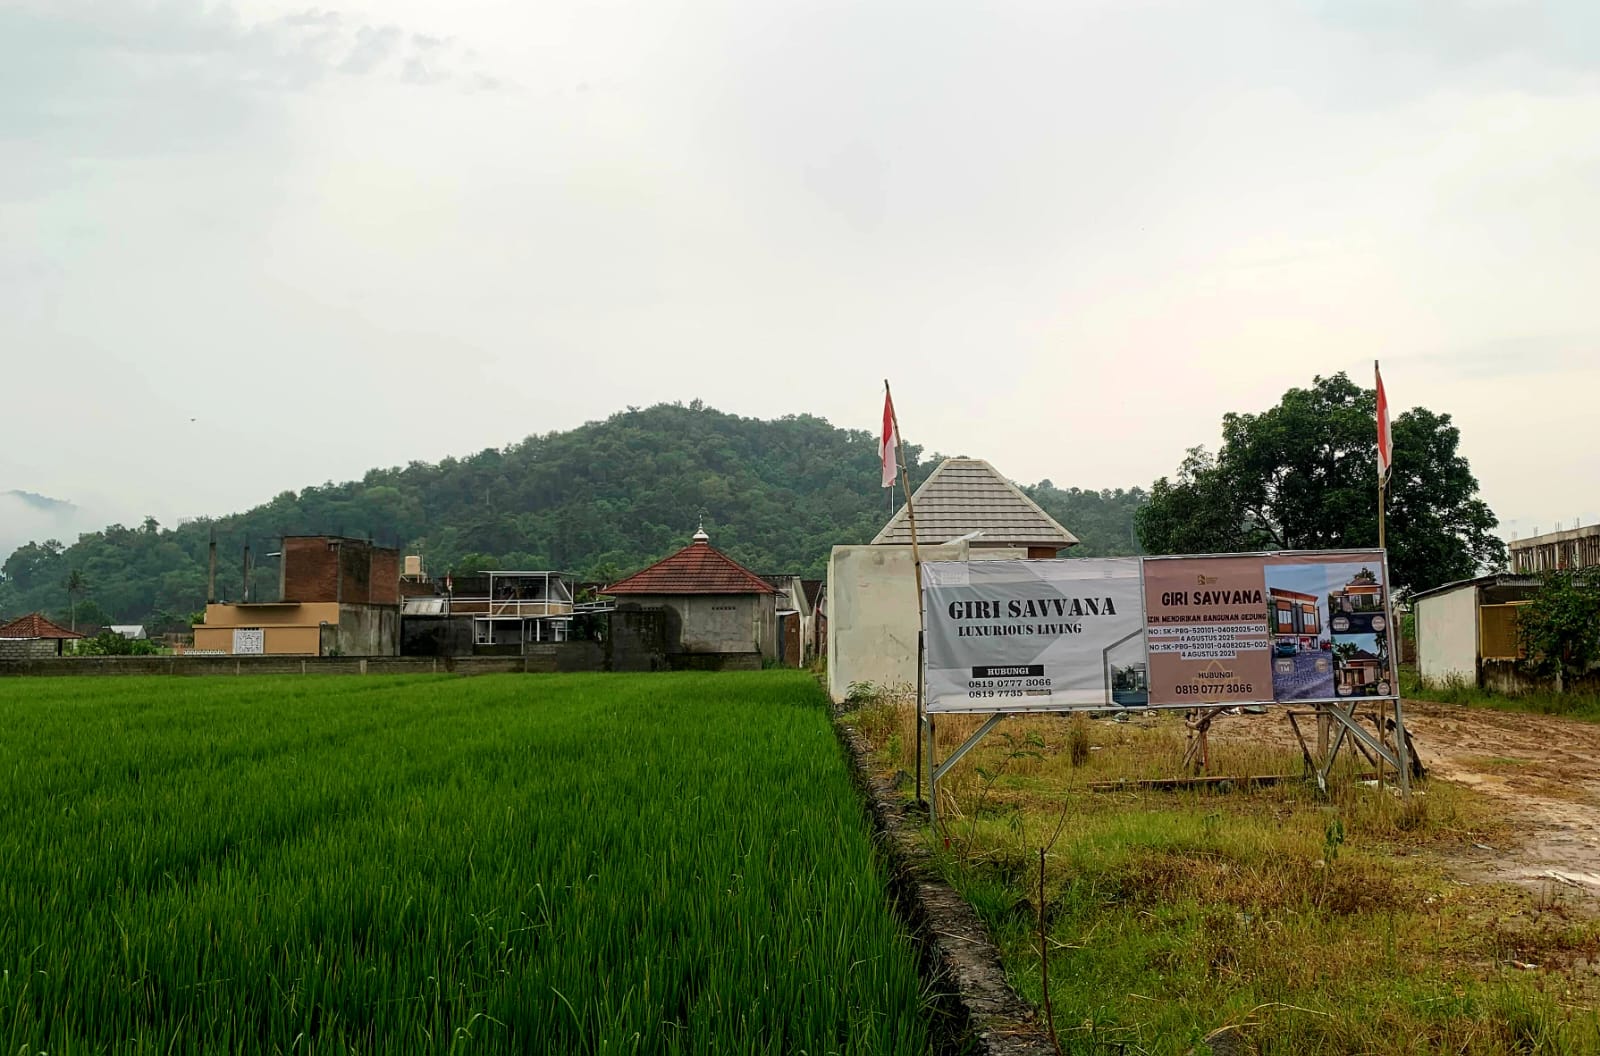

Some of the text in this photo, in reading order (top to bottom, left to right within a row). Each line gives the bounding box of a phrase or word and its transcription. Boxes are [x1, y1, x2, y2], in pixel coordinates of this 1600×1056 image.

[1162, 590, 1262, 606] GIRI SAVVANA
[949, 597, 1116, 619] GIRI SAVVANA
[1147, 613, 1267, 623] IZIN MENDIRIKAN BANGUNAN GEDUNG
[958, 624, 1082, 637] LUXURIOUS LIVING
[987, 667, 1029, 676] HUBUNGI
[1198, 671, 1233, 679] HUBUNGI
[968, 678, 1052, 688] 0819 0777 3066
[968, 690, 994, 699] 0819
[997, 689, 1023, 697] 7735
[1175, 683, 1253, 695] 0819 0777 3066
